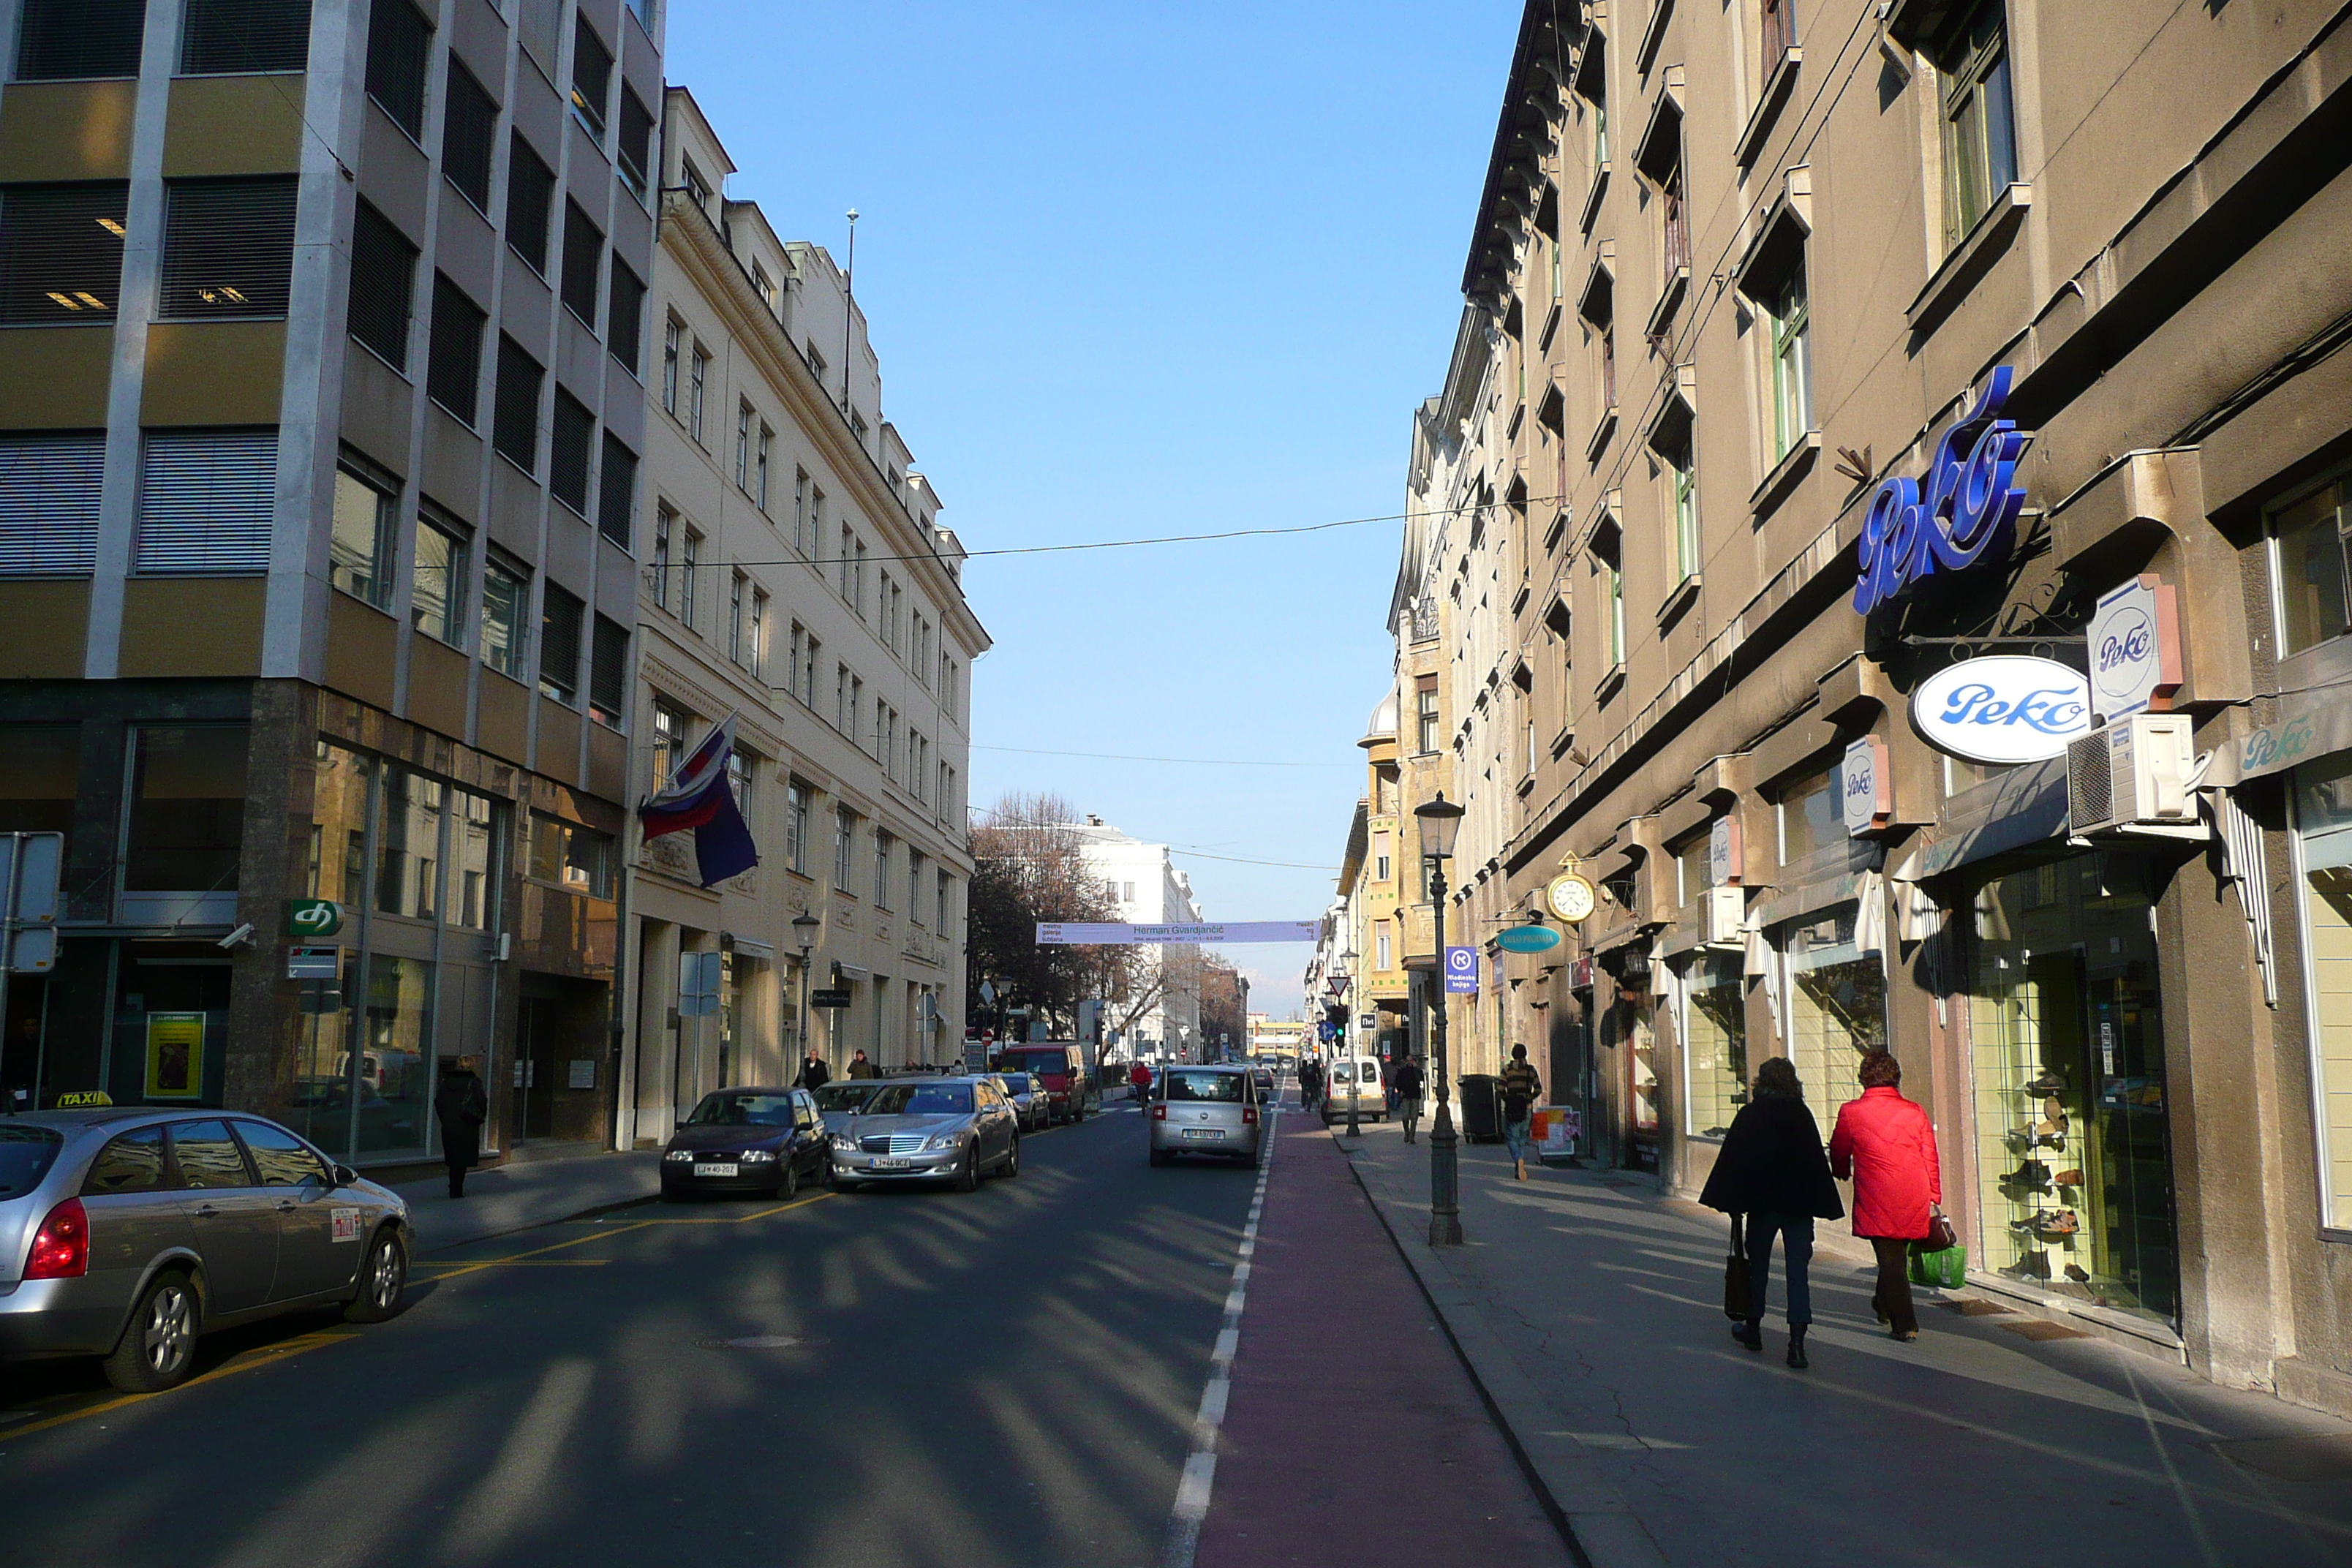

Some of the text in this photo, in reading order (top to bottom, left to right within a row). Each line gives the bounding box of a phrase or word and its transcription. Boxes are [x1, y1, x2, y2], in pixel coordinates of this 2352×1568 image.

[1852, 366, 2027, 616] Peko
[2100, 618, 2151, 673] Peko
[1940, 683, 2087, 735] Peko
[2242, 714, 2313, 771] Peko
[1847, 767, 1872, 798] Peko
[1134, 926, 1169, 935] Herman
[64, 1093, 98, 1106] TAXI
